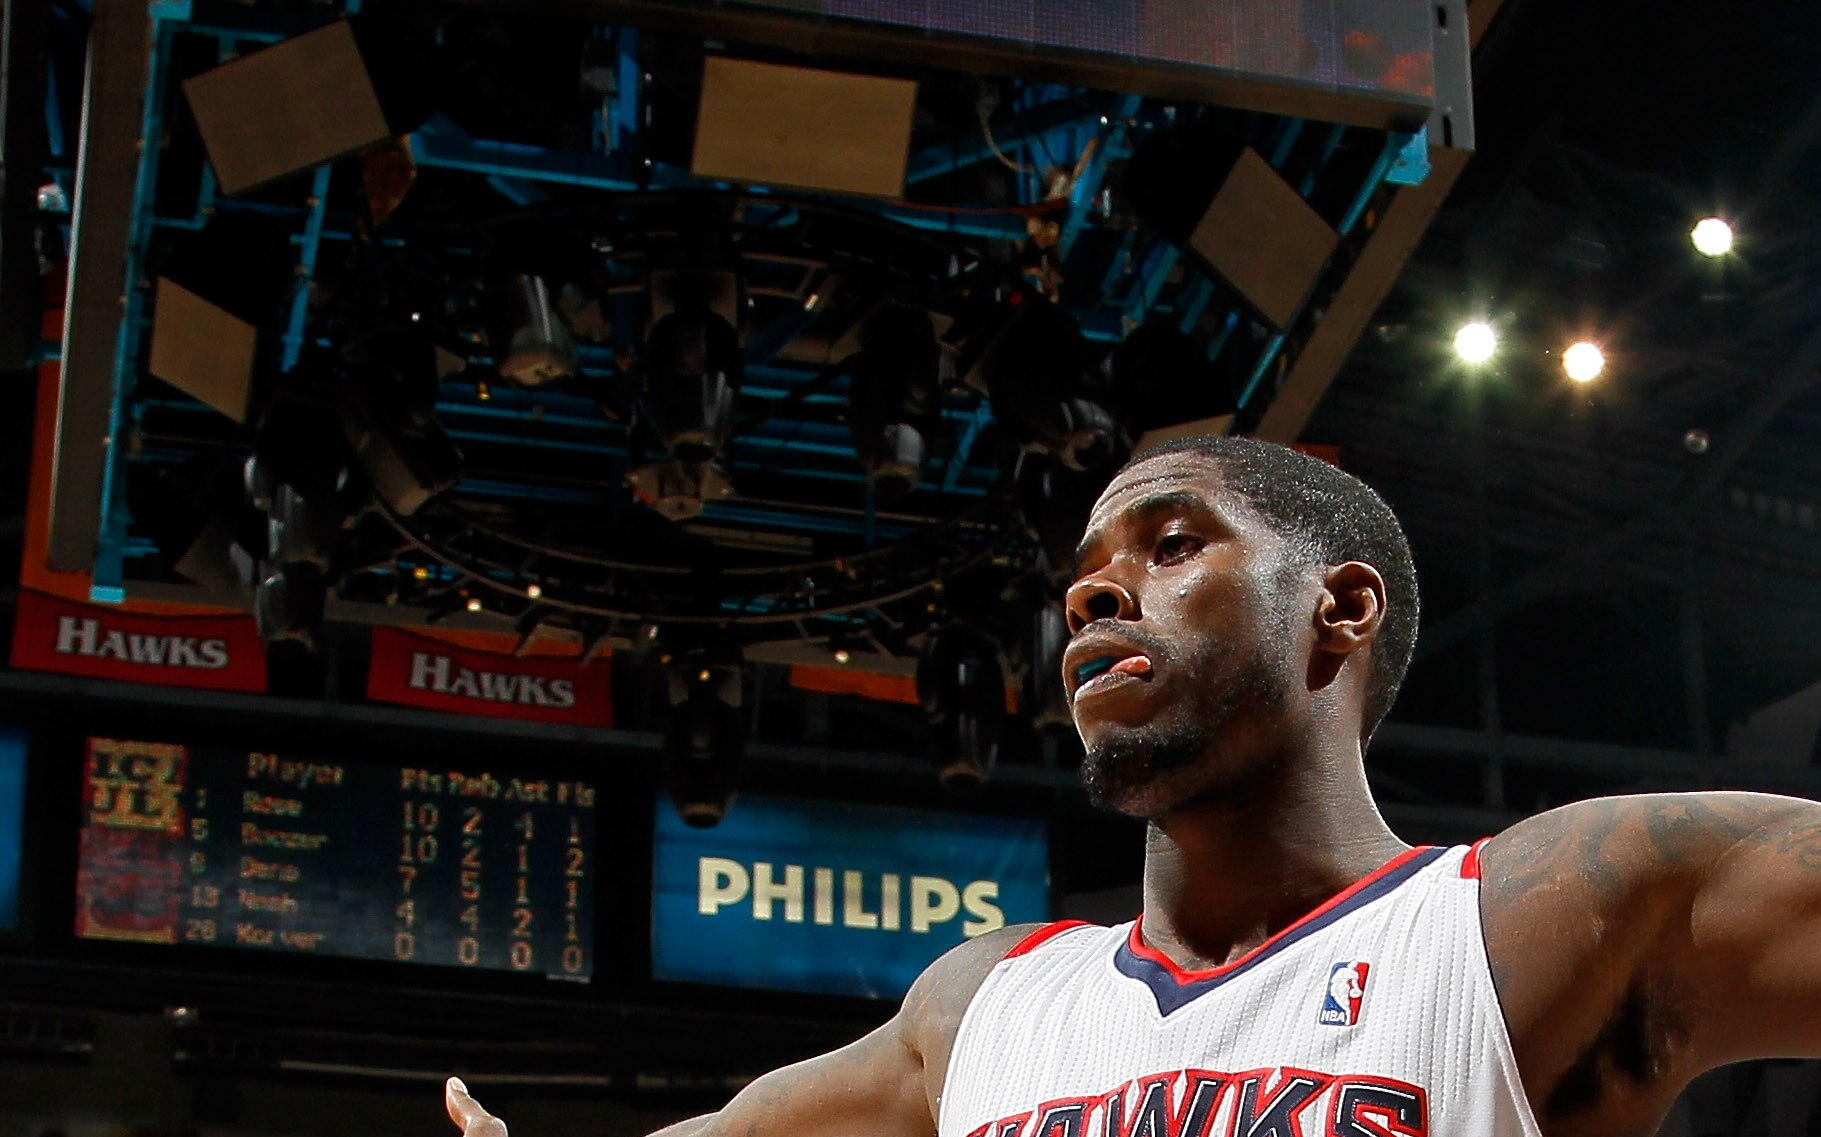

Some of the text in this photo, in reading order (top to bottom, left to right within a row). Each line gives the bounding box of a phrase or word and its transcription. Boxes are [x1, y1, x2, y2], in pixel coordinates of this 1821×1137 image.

[402, 801, 439, 832] 10
[462, 806, 482, 836] 2
[401, 833, 438, 864] 10
[565, 847, 584, 878] 2
[398, 864, 418, 895] 7
[461, 871, 481, 900] 5
[698, 856, 1005, 937] PHILIPS
[395, 899, 415, 929] 4
[461, 904, 480, 932] 4
[513, 907, 533, 938] 2
[394, 931, 415, 962] 0
[458, 936, 480, 967] 0
[510, 940, 533, 971] 0
[561, 944, 583, 975] 0
[1320, 1010, 1345, 1022] NBA
